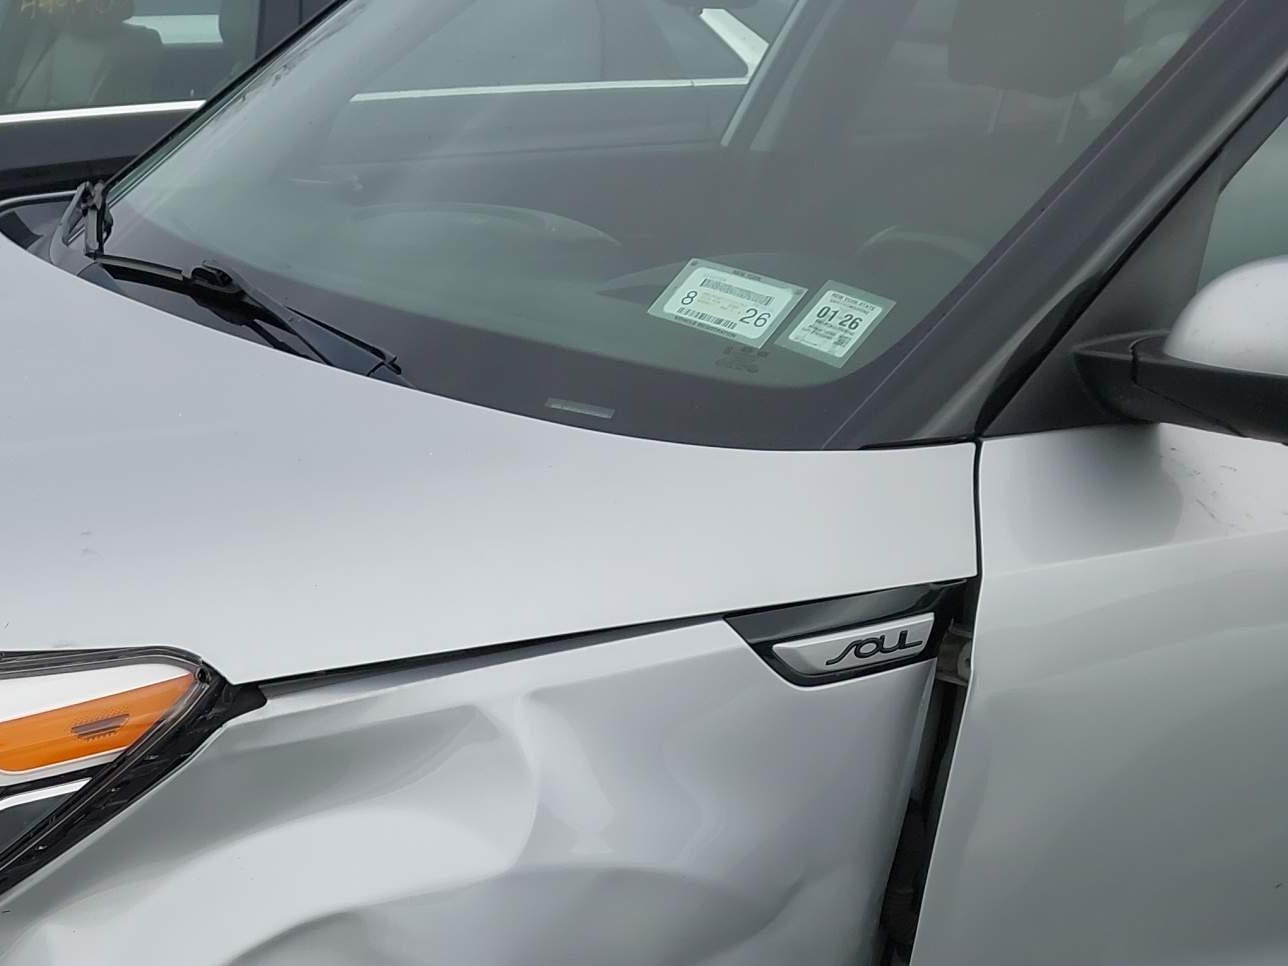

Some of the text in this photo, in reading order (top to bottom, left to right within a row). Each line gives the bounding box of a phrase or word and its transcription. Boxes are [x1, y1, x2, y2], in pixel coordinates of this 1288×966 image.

[681, 291, 697, 305] 8
[739, 308, 771, 327] 26
[817, 306, 839, 321] 01
[838, 314, 863, 330] 26
[825, 630, 923, 666] SOUL
